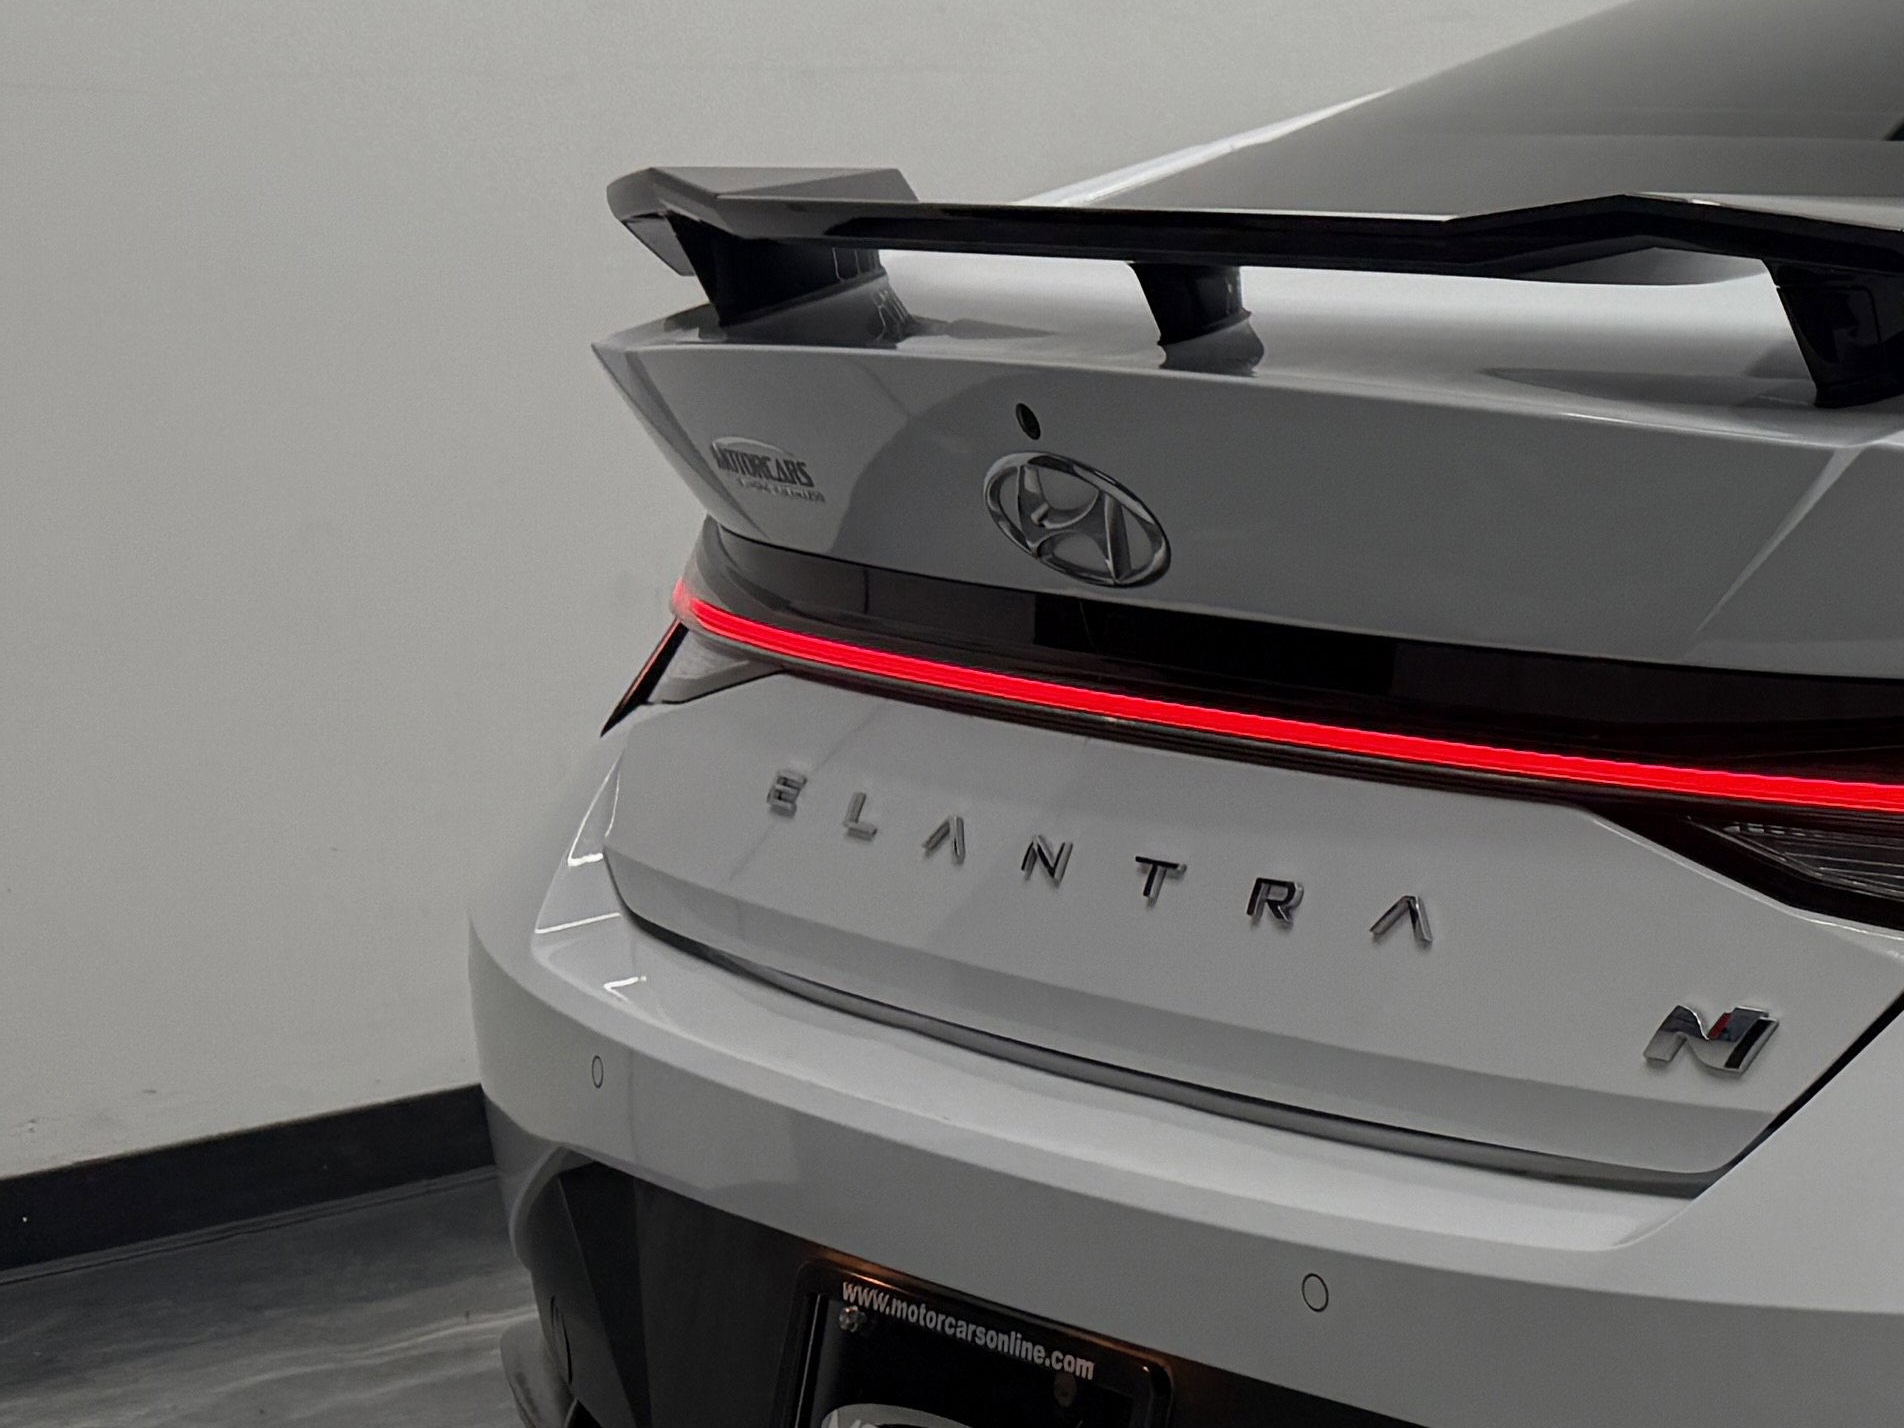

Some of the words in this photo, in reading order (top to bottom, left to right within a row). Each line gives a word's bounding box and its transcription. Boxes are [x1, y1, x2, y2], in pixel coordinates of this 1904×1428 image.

[766, 772, 1434, 948] ELANTRA
[1643, 1004, 1781, 1079] N
[842, 1280, 1096, 1381] www.motorcarsonline.com
